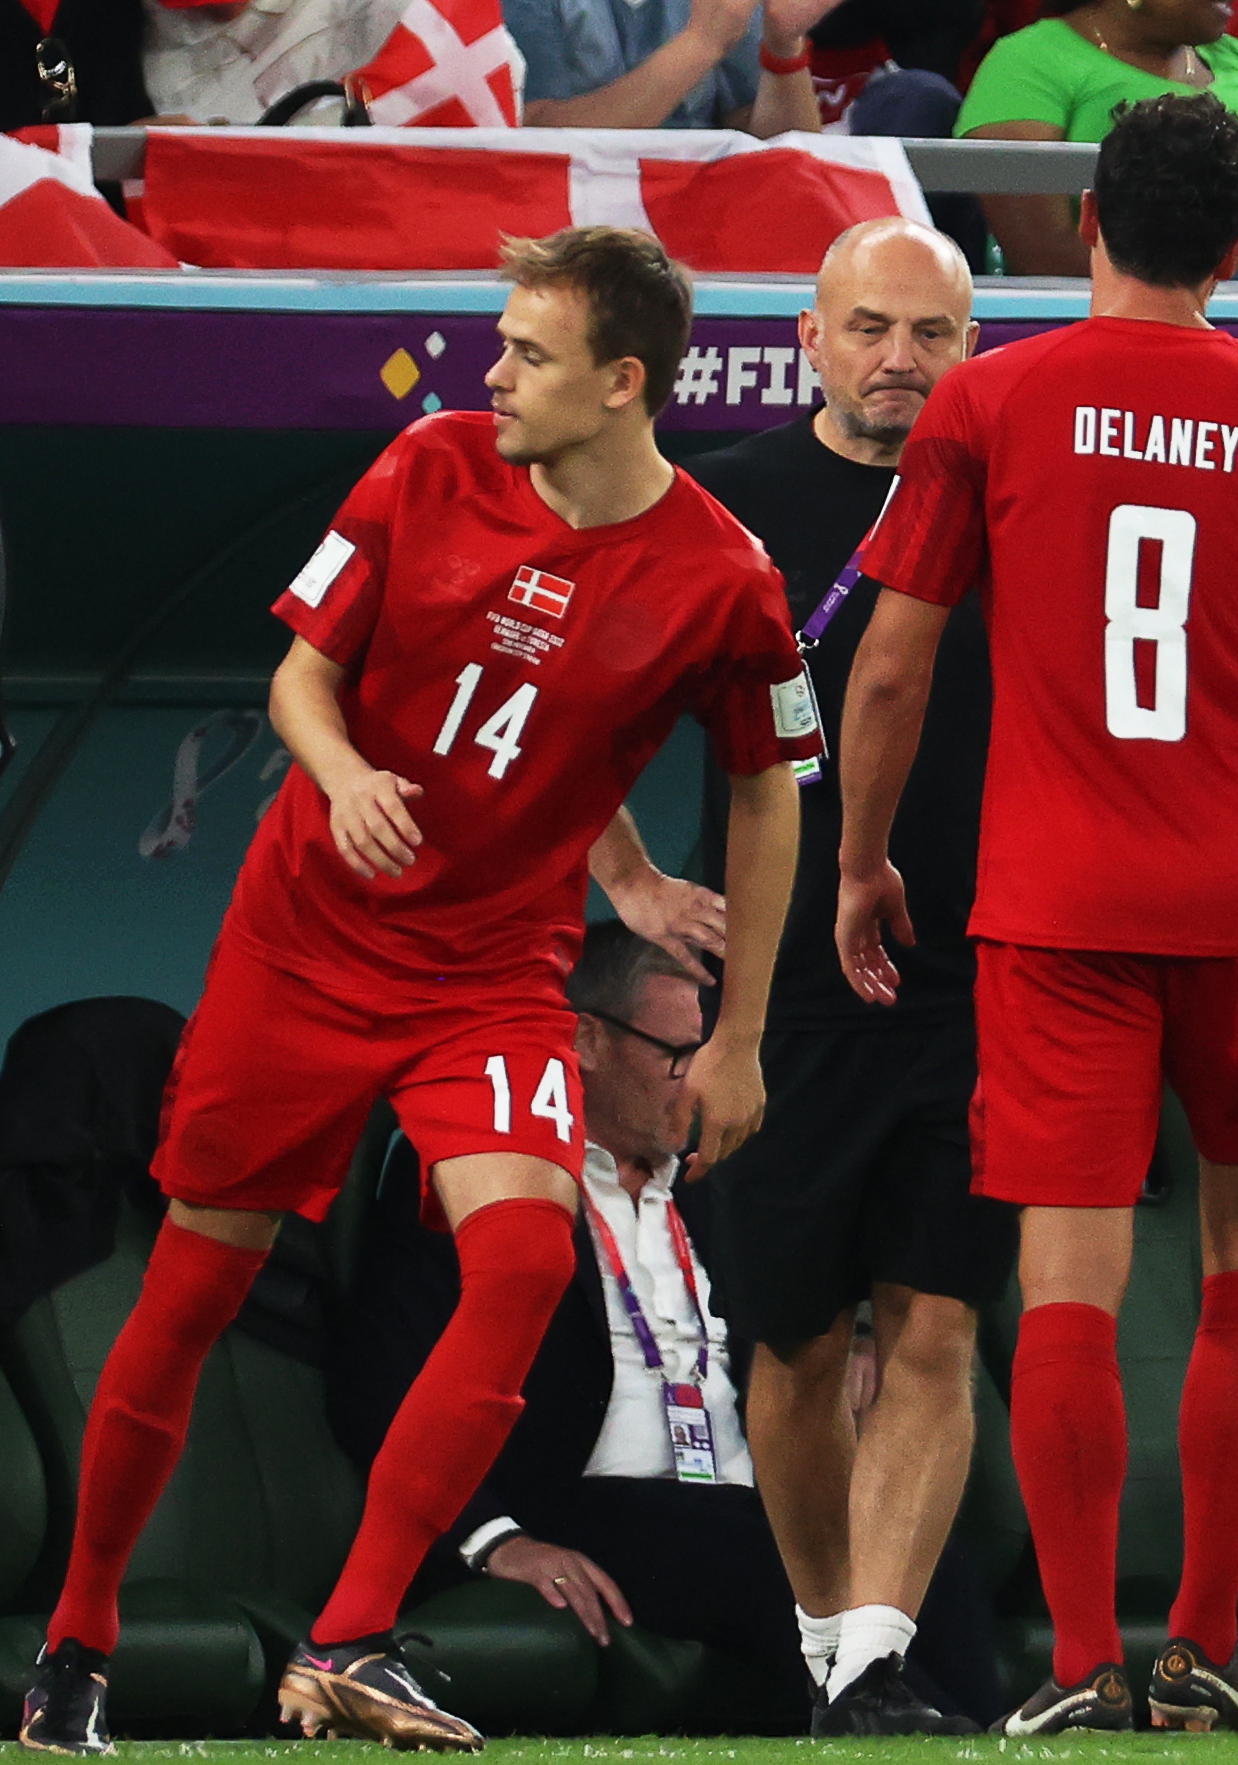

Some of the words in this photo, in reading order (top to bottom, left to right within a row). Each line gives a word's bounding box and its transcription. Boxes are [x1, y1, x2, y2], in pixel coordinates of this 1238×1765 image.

[1104, 504, 1198, 742] 8
[432, 662, 538, 780] 14
[484, 1055, 574, 1144] 14
